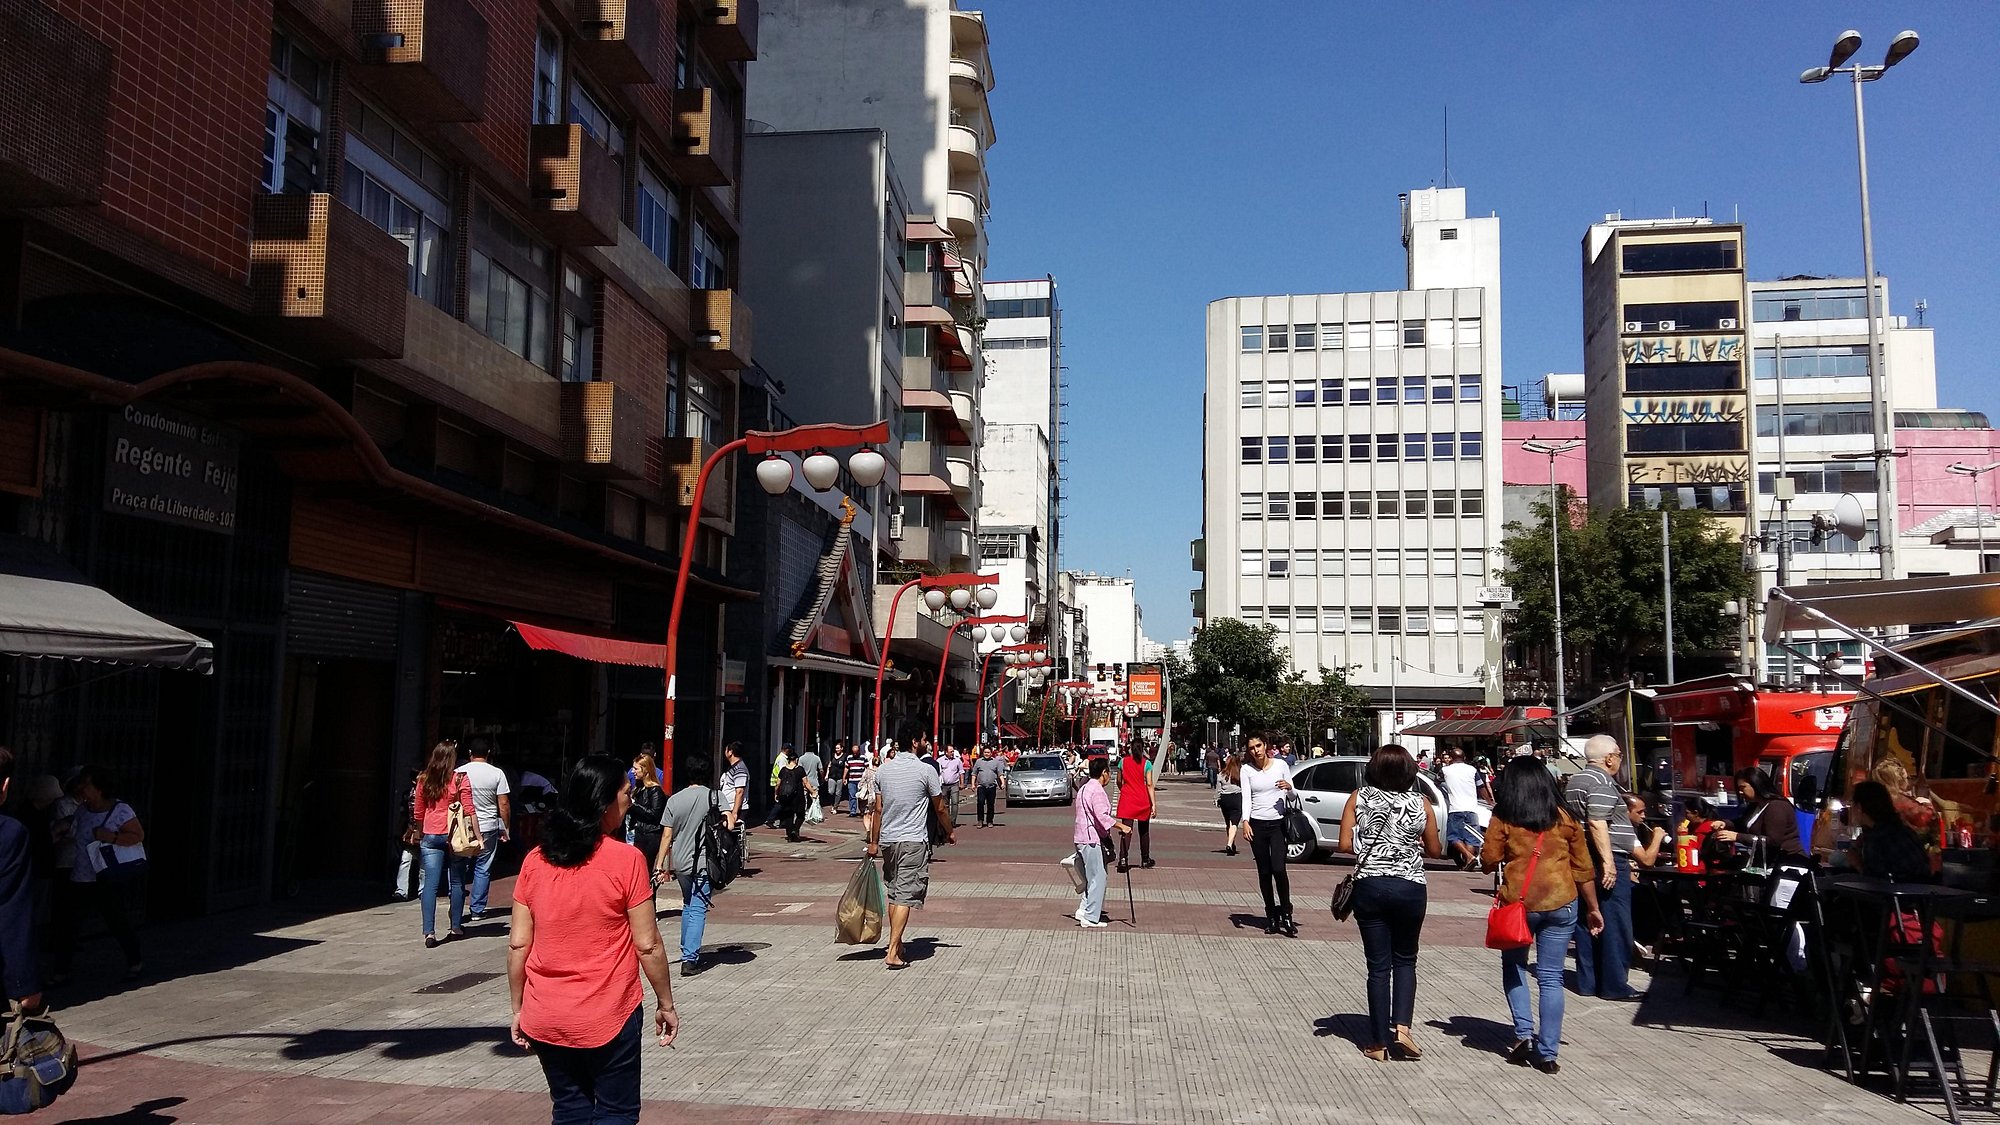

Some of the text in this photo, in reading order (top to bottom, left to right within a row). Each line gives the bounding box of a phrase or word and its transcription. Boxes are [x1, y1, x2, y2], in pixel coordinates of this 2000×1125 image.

[115, 437, 192, 478] Regente
[112, 488, 147, 512] Praça
[149, 494, 165, 513] da
[166, 498, 215, 524] Liberdade
[219, 511, 236, 528] 107
